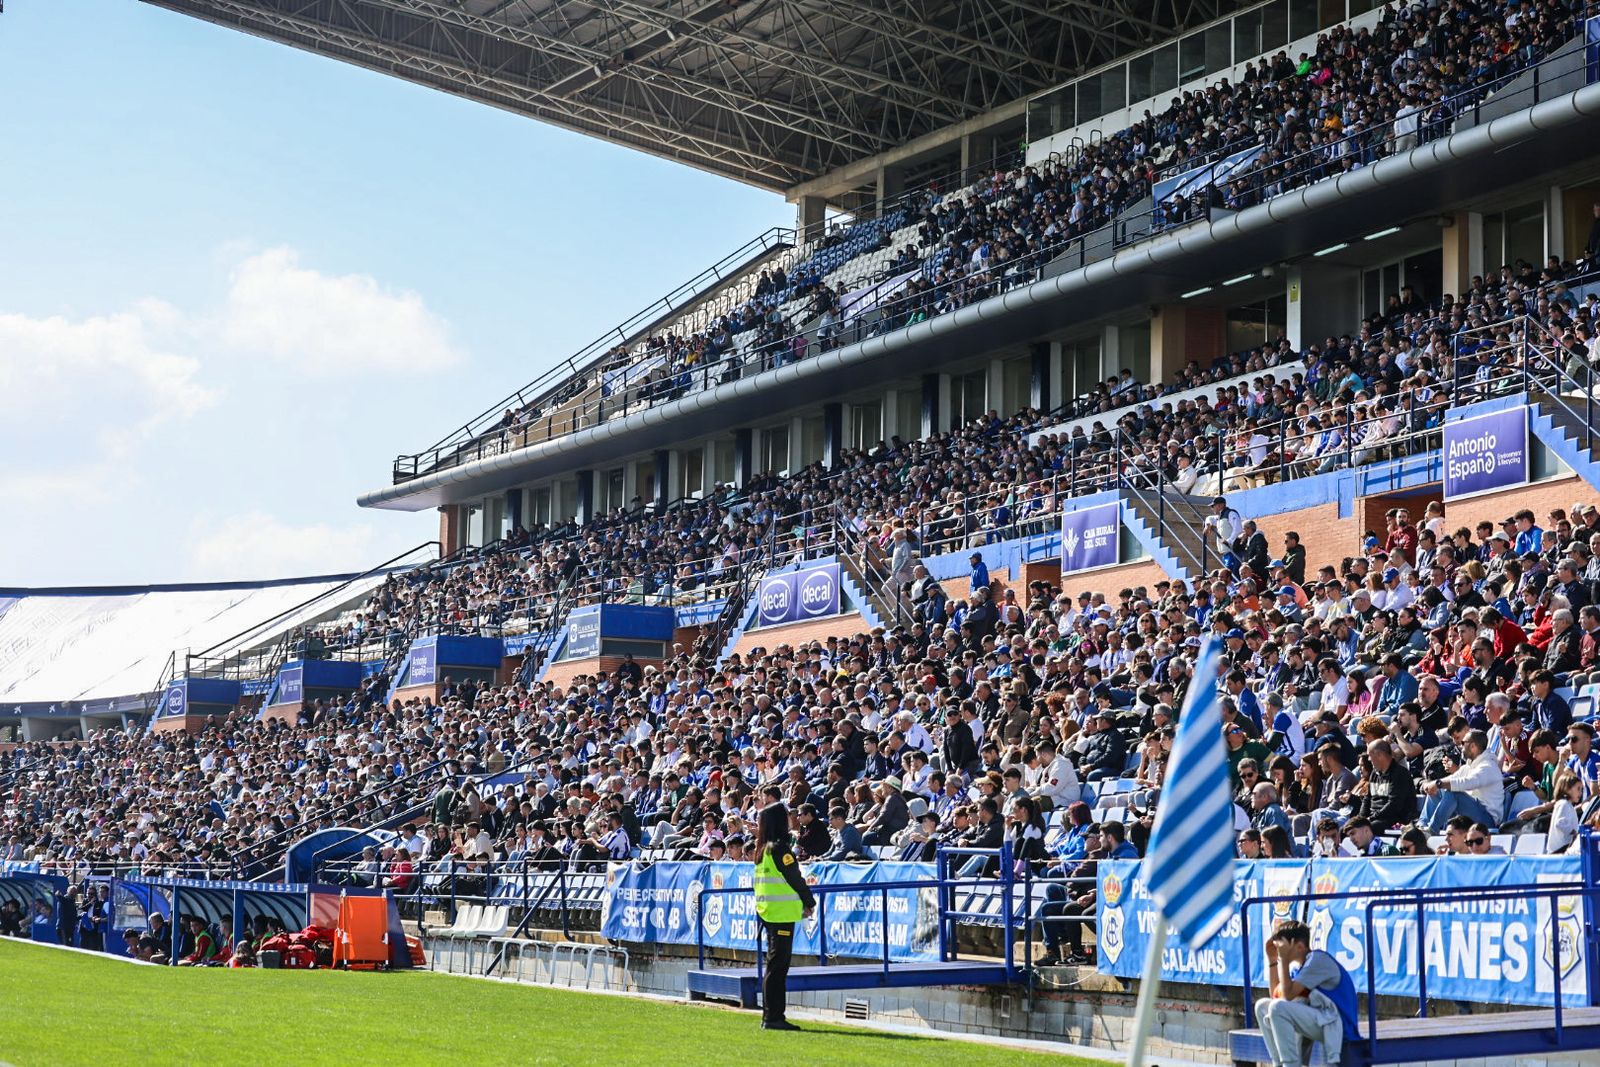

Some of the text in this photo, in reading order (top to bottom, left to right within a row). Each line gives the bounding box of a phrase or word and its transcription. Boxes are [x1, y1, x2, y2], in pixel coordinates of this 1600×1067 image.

[1449, 431, 1496, 459] Antonio
[1096, 524, 1116, 537] RURAL
[1084, 536, 1107, 550] DEL SUR
[762, 589, 788, 611] decal
[802, 581, 831, 604] decal
[169, 694, 183, 706] decal
[728, 894, 745, 915] LAS
[731, 918, 747, 940] DEL
